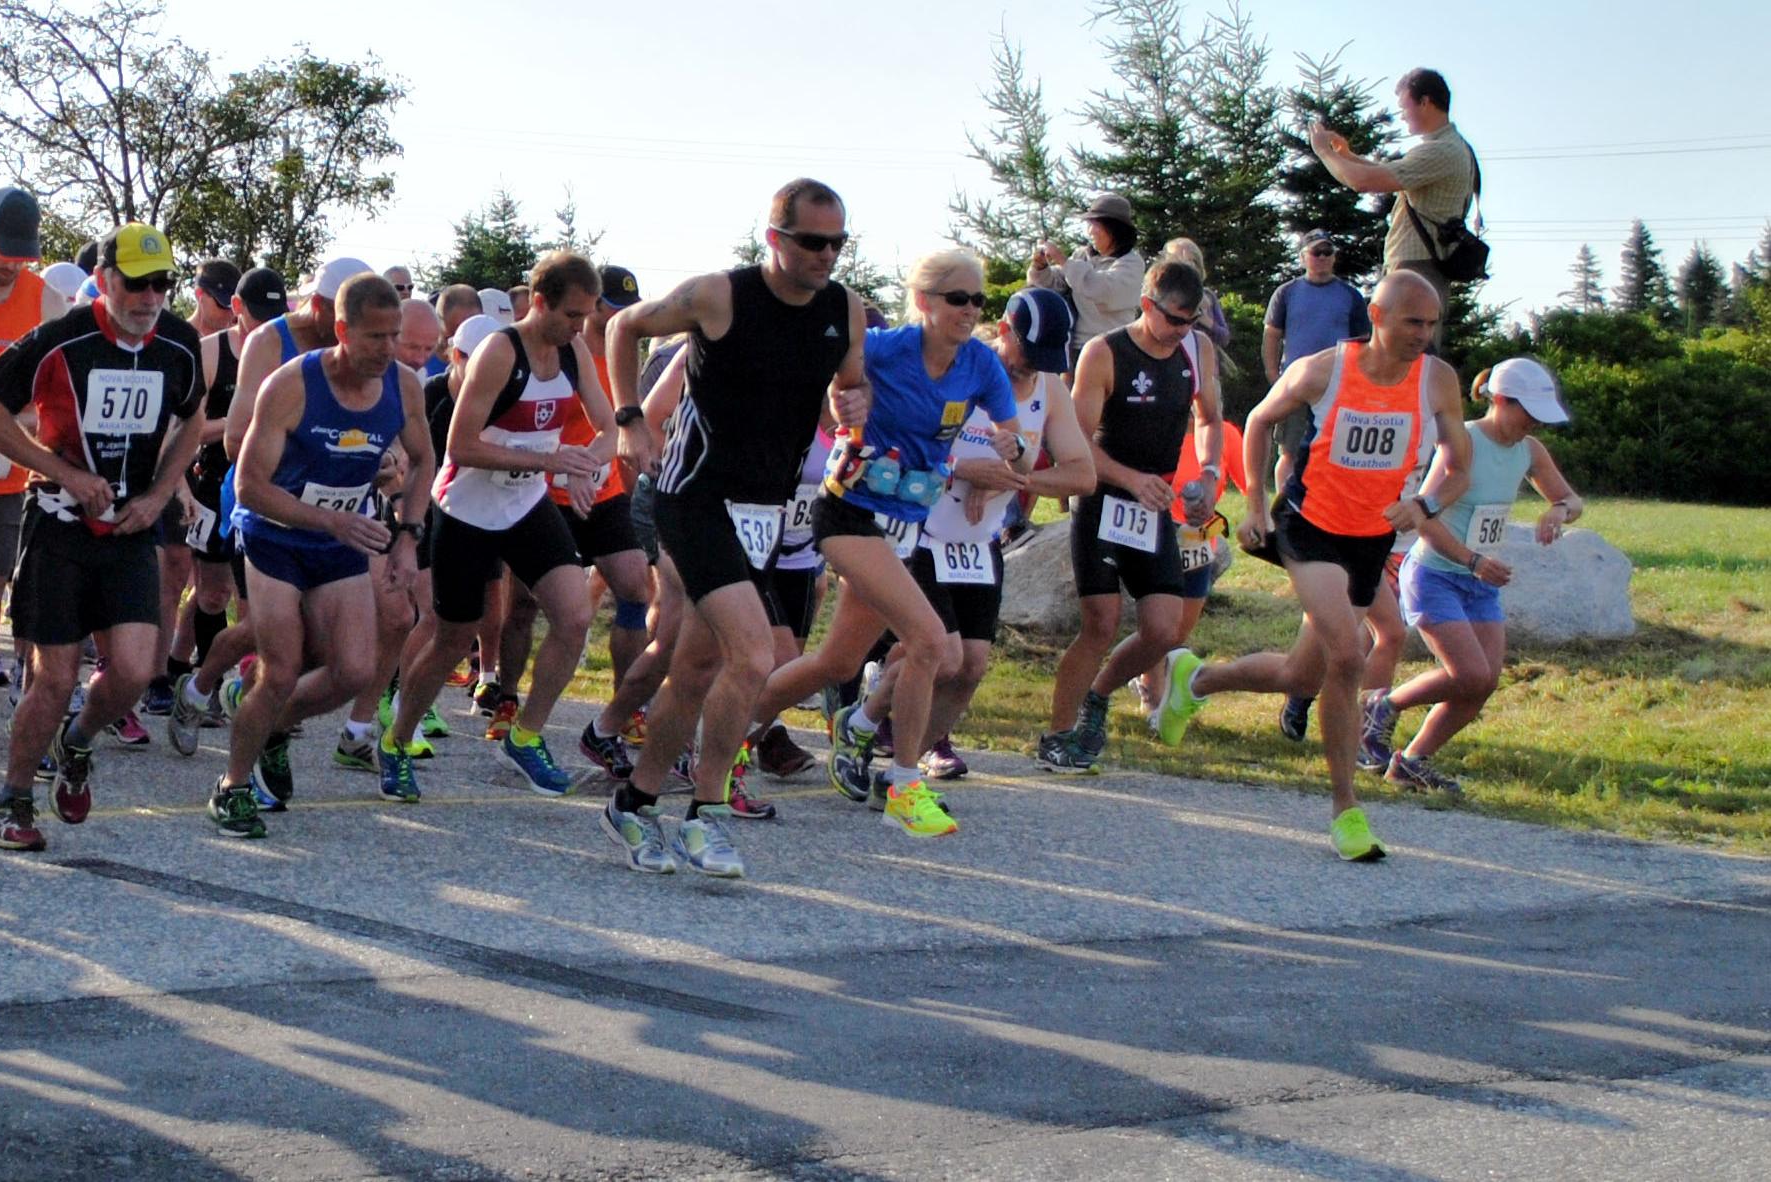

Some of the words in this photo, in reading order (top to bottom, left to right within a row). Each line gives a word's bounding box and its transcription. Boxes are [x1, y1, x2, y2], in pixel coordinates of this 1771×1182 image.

[100, 374, 122, 383] NOVA
[124, 375, 153, 384] SCOTIA
[101, 387, 148, 420] 570
[98, 422, 142, 430] MARATHON
[1343, 412, 1370, 425] Nova
[1372, 415, 1404, 426] Scotia
[1346, 425, 1396, 455] 008
[1340, 456, 1392, 468] Marathon
[1113, 502, 1148, 536] 015
[740, 518, 773, 554] 539
[944, 542, 983, 570] 662
